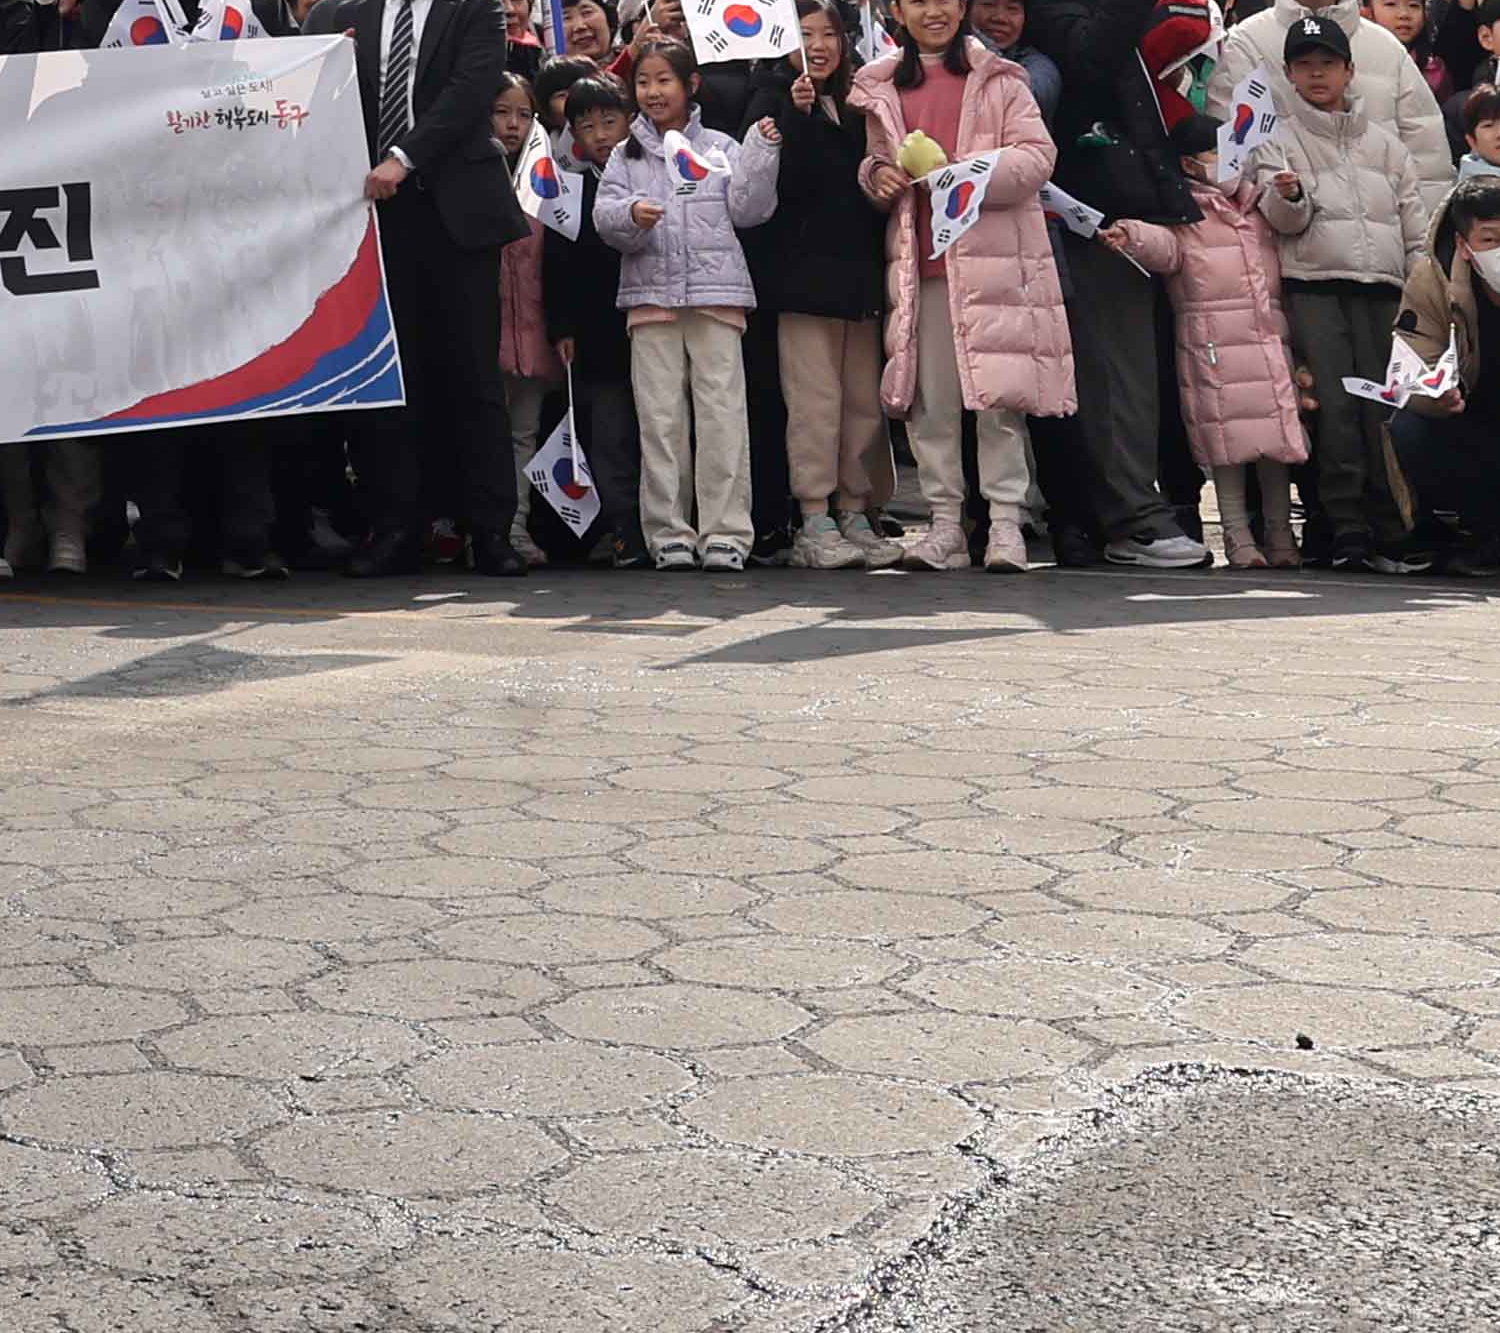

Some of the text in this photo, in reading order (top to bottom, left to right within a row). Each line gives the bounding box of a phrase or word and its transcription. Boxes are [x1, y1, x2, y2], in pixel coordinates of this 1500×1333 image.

[1303, 18, 1321, 35] LA
[166, 99, 310, 134] 활기찬 행복도시 동구
